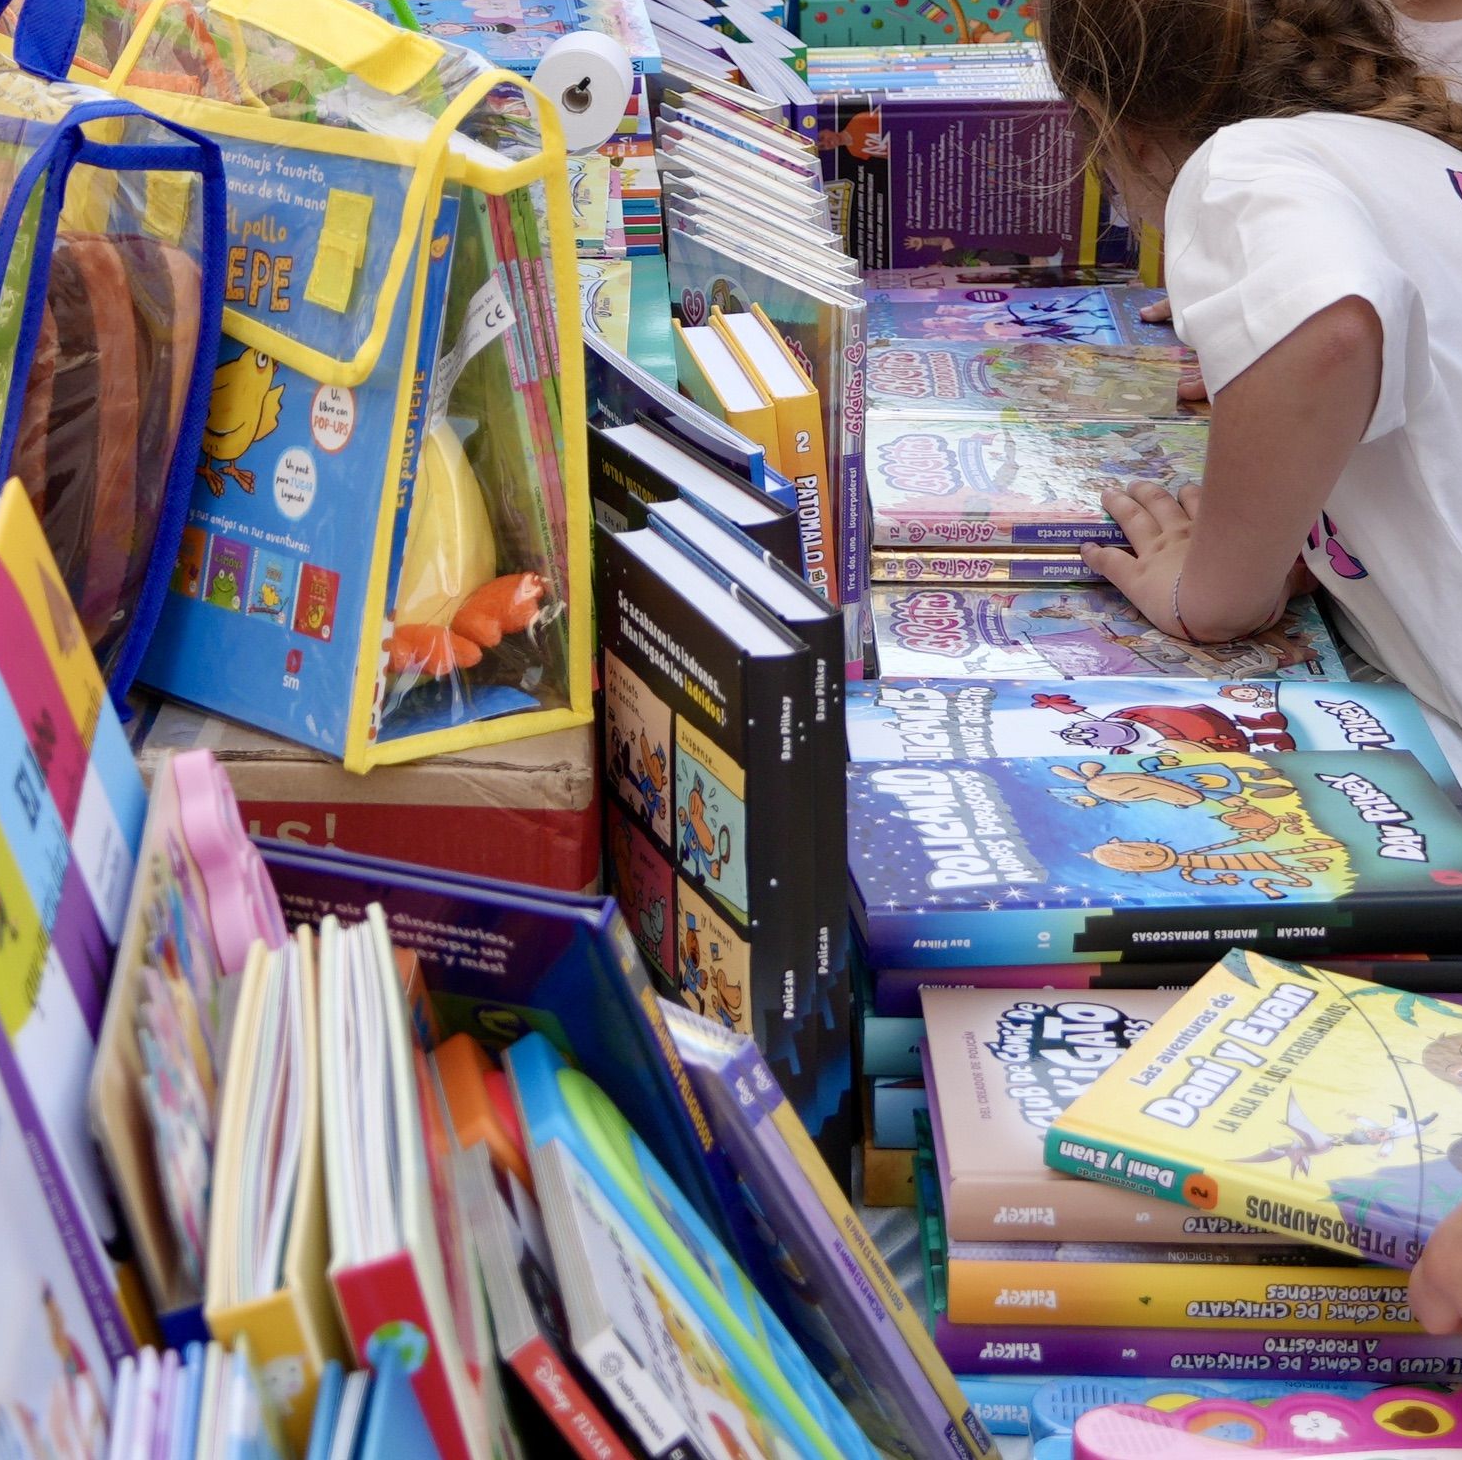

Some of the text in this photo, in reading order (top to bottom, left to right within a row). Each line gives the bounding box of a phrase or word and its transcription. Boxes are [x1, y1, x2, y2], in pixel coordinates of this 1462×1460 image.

[275, 156, 327, 187] favorito,
[258, 180, 327, 211] de tu mano
[242, 213, 287, 245] pollo
[225, 246, 293, 312] EPE
[485, 303, 506, 328] CE
[319, 402, 335, 415] libro
[313, 413, 349, 436] POP-UPS
[401, 370, 426, 480] pollo PEPE
[285, 458, 310, 475] Un pack
[795, 430, 824, 563] 2 PATOMALO
[847, 466, 860, 528] ¡superpoderes!
[195, 510, 311, 554] sus amigos en sus aventuras:
[889, 527, 900, 540] 12
[1037, 529, 1124, 540] la hermana secreta
[847, 552, 859, 569] dos,
[886, 561, 898, 576] 15
[1042, 565, 1081, 577] Navidad
[847, 570, 860, 593] Tres,
[617, 589, 726, 702] Se acabaron los ladrones...
[282, 675, 300, 691] sm
[617, 670, 639, 699] relato
[620, 614, 727, 728] ¡Han llegado los ladridos!
[816, 658, 827, 722] Dav Pilkey
[781, 696, 793, 761] Dav Pilkey
[1378, 823, 1429, 862] DAV
[392, 912, 515, 948] dinosaurios,
[912, 937, 971, 950] Dav Pilkey
[1037, 931, 1051, 948] 10
[1131, 925, 1326, 943] POLICÁN MADRES BORRASCOSAS
[481, 946, 507, 960] un
[818, 926, 829, 975] Policán
[783, 969, 795, 1019] Policán
[1219, 982, 1319, 1047] Evan
[1131, 993, 1235, 1087] Las aventuras de
[1209, 1039, 1268, 1068] y
[964, 1030, 993, 1120] DEL CREADOR DE POLICÁN
[1214, 1002, 1352, 1134] LA ISLA DE LOS PTEROSAURIOS
[1059, 1140, 1176, 1188] Dani y Evan
[1077, 1166, 1090, 1177] de
[1090, 1171, 1138, 1193] aventuras
[1190, 1186, 1209, 1199] 2
[1245, 1194, 1396, 1260] PTEROSAURIOS
[1168, 1250, 1213, 1264] EDICIÓN
[1367, 1338, 1380, 1352] A
[1399, 1355, 1446, 1374] CLUB
[615, 1377, 665, 1441] baby einstein
